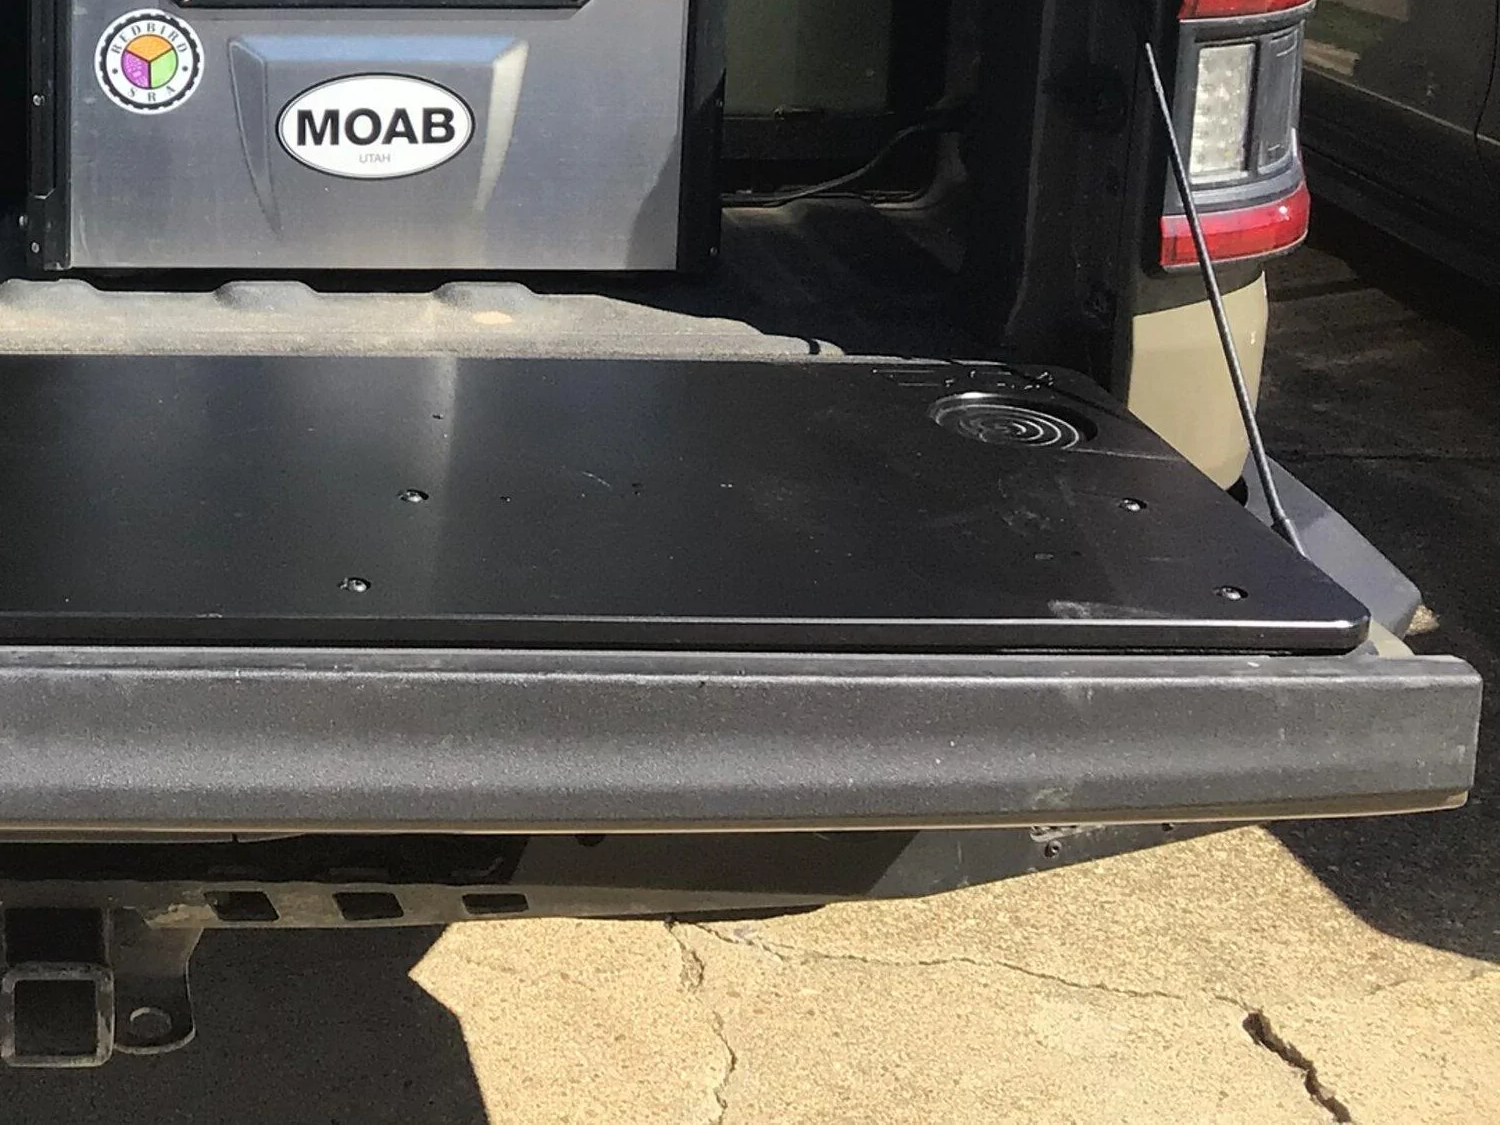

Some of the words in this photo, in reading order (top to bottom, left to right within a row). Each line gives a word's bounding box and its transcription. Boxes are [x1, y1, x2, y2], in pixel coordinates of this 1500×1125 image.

[111, 22, 188, 55] REDBIRD
[297, 107, 456, 146] MOAB
[358, 153, 391, 164] UTAH
